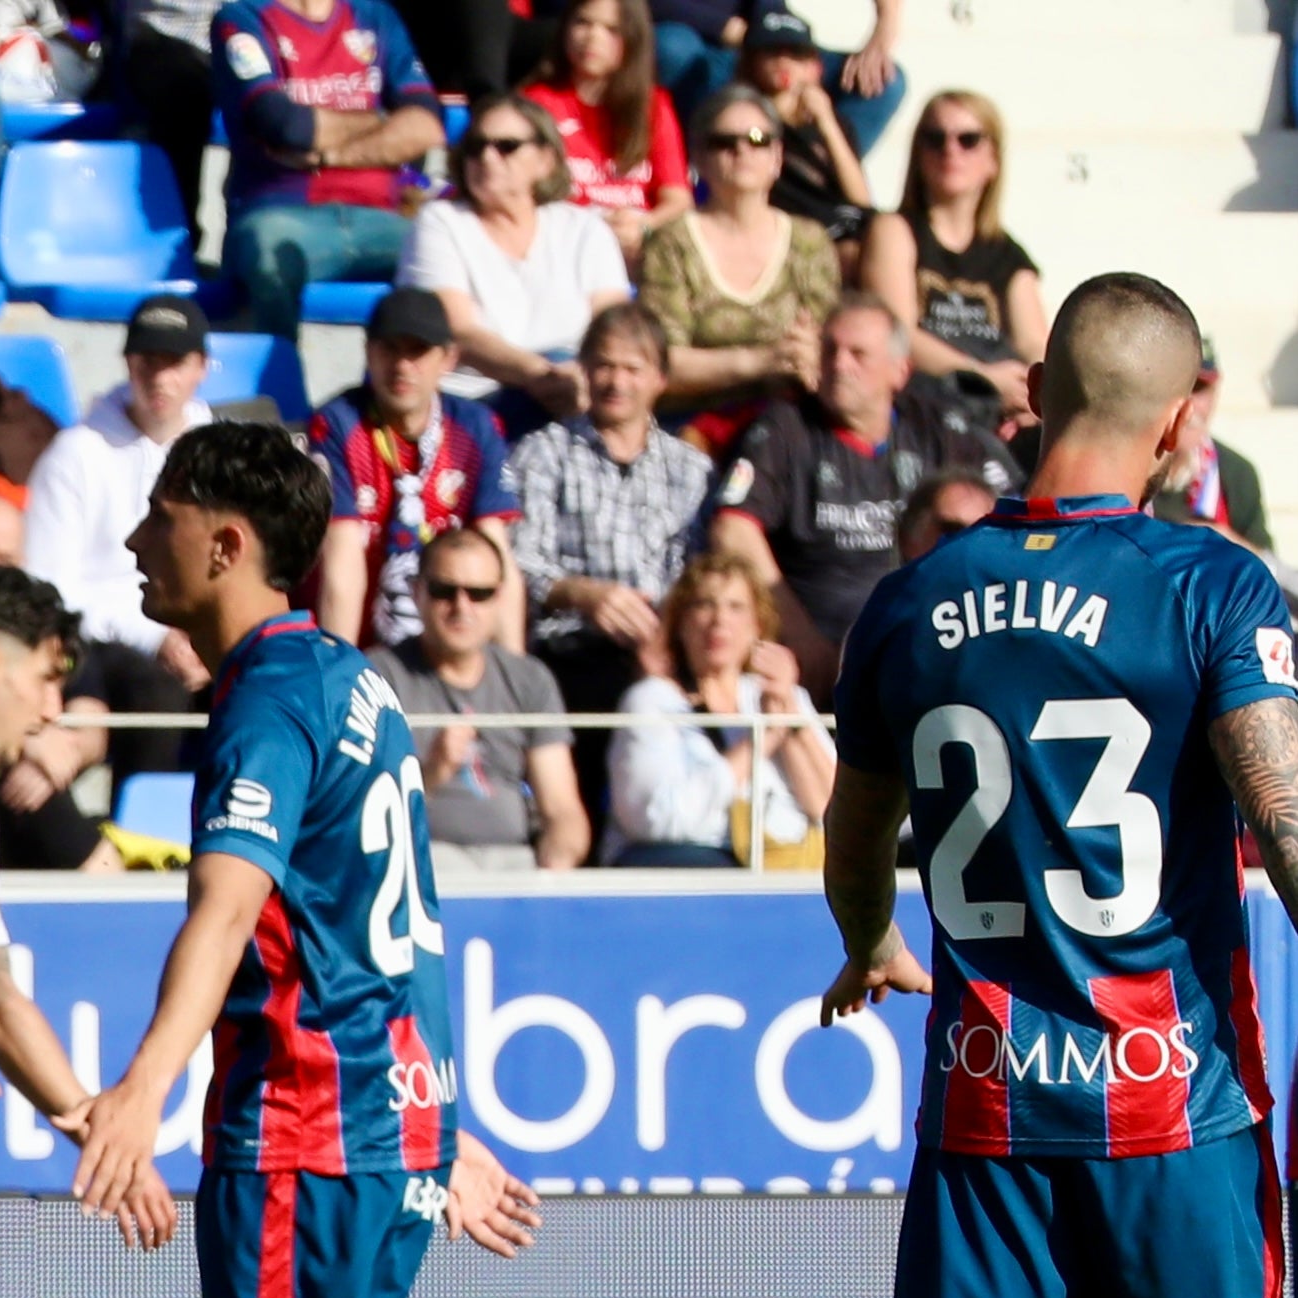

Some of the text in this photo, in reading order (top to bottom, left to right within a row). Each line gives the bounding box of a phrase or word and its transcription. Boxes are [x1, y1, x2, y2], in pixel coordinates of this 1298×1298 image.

[931, 579, 1109, 650] SIELVA
[913, 698, 1163, 940] 23
[939, 1021, 1200, 1085] SOMMOS
